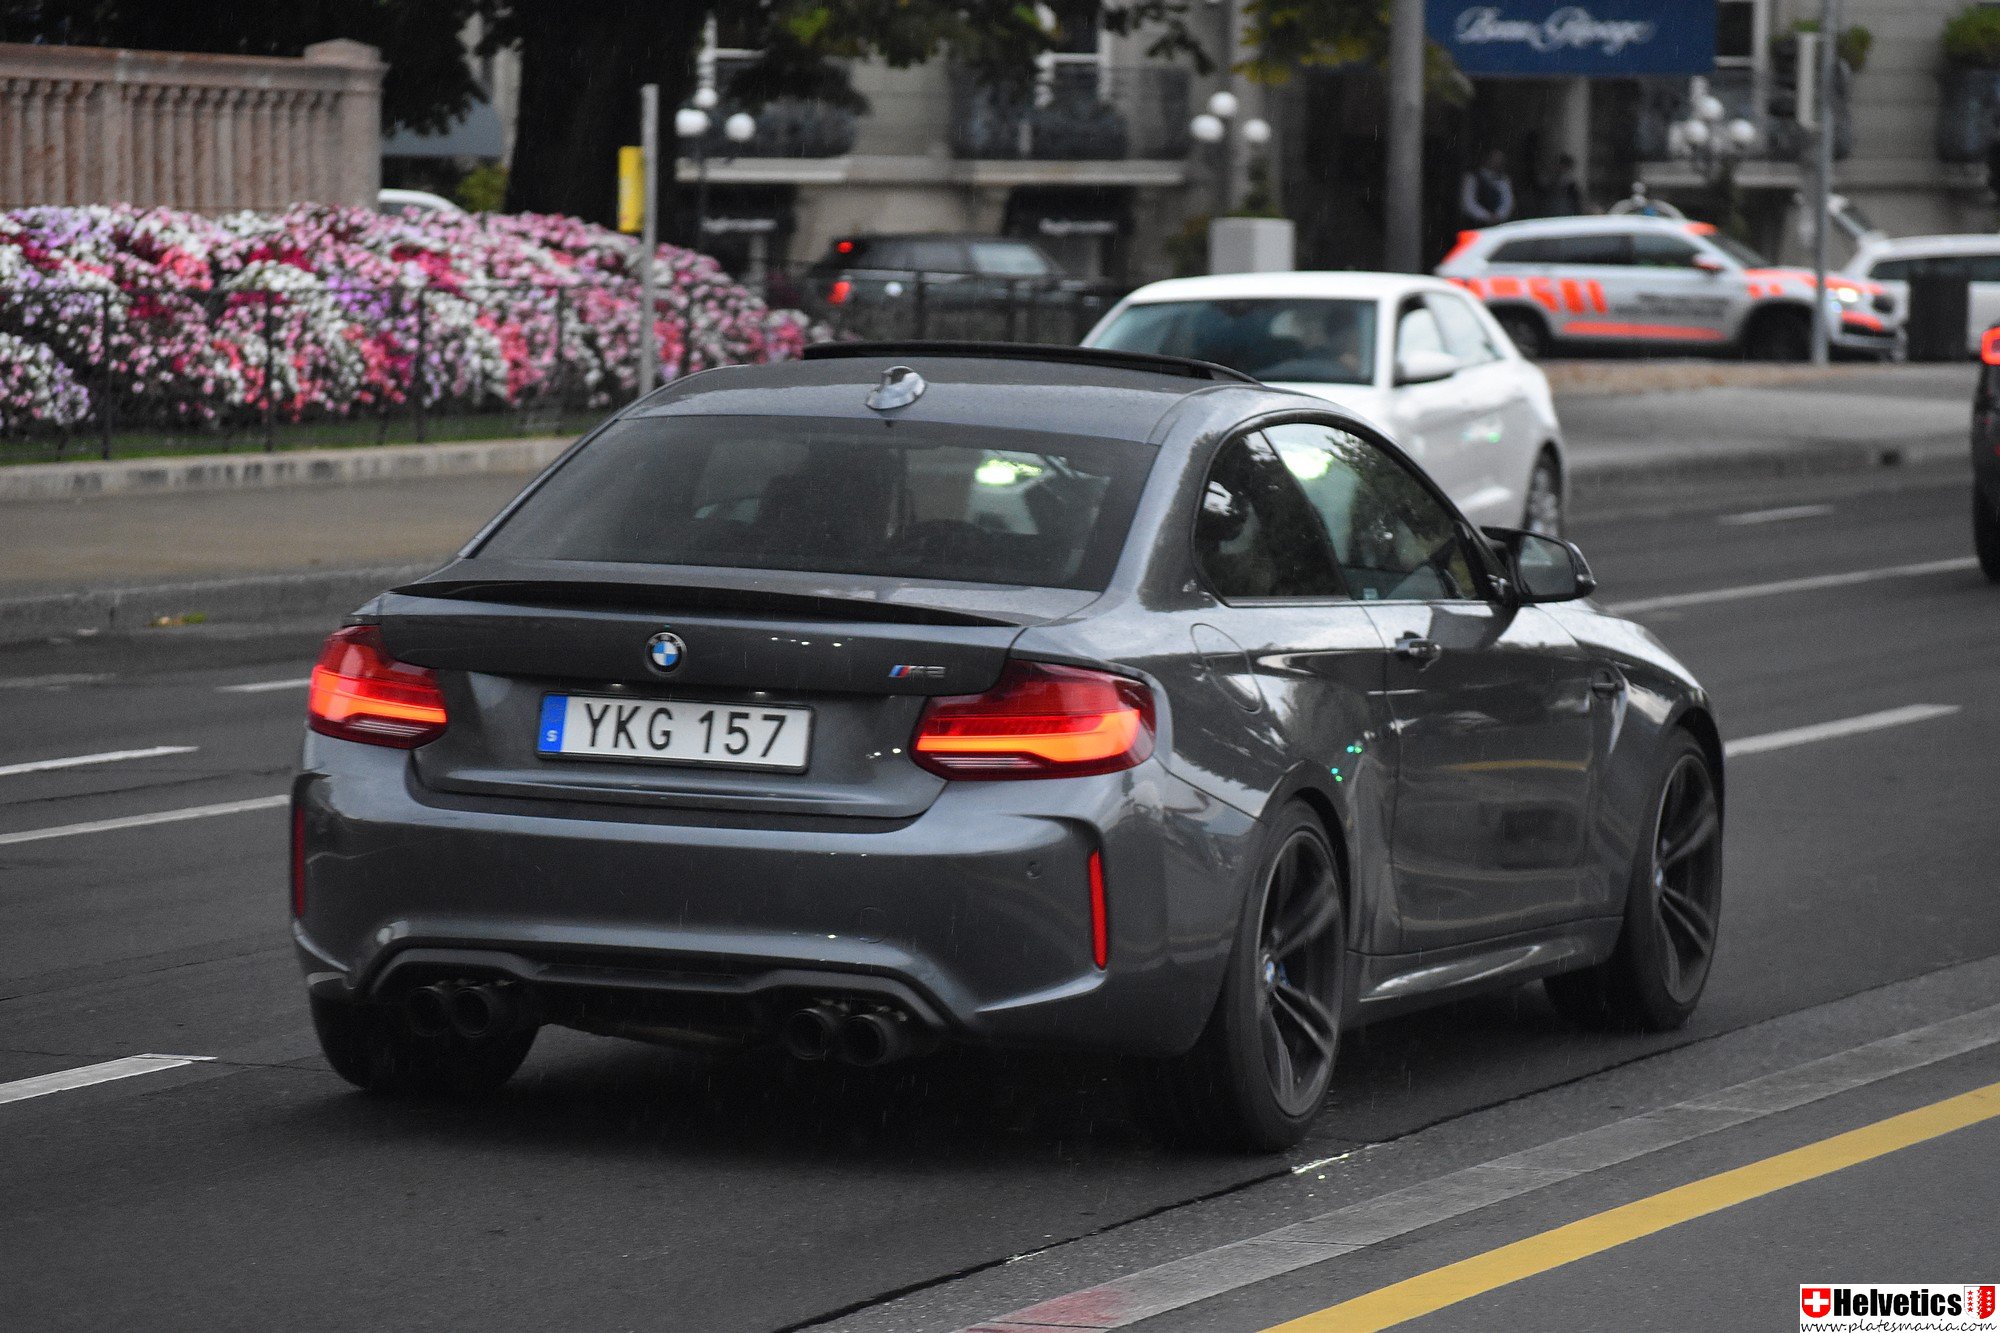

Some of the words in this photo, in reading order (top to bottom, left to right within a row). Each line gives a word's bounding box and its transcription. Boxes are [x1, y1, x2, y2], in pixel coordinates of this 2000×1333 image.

[546, 729, 558, 742] S
[584, 703, 673, 751] YKG
[698, 710, 787, 758] 157
